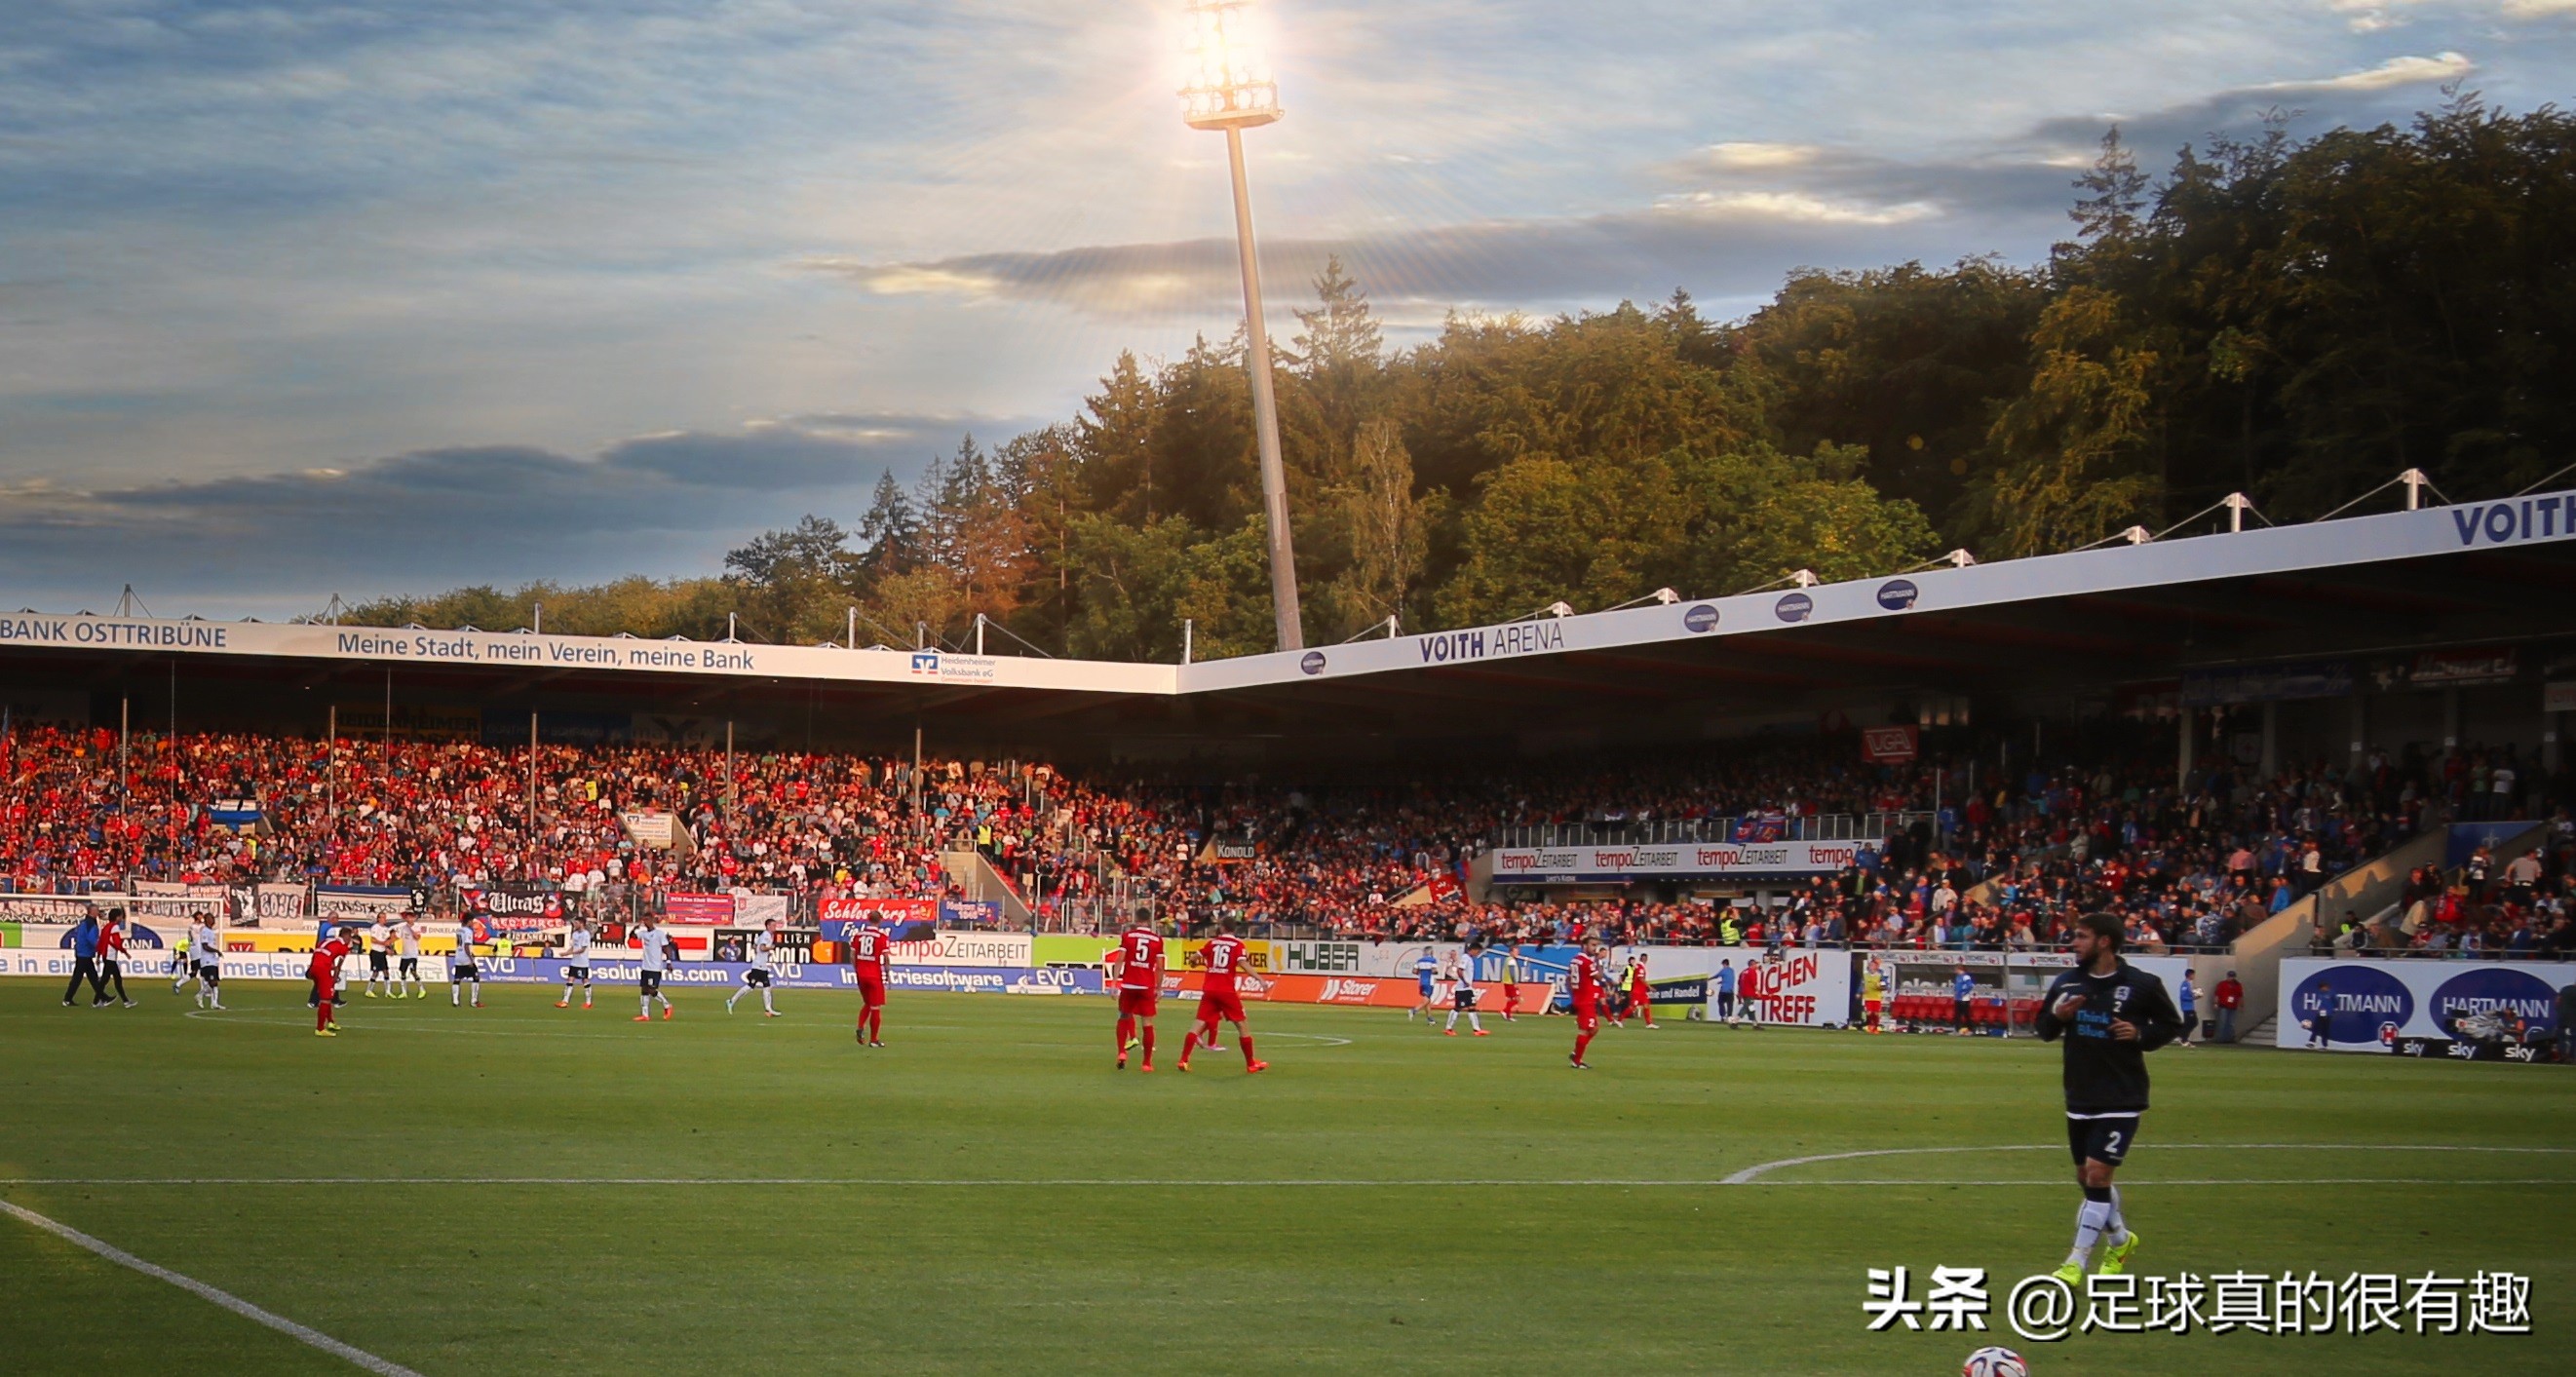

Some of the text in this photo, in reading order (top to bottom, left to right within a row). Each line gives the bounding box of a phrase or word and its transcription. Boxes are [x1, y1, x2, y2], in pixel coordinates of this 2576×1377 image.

[0, 620, 227, 649] BANK OSTTRIBÜNE
[1419, 622, 1564, 663] VOITH ARENA
[337, 633, 754, 669] Meine Stadt, mein Verein, meine Bank
[1217, 844, 1254, 858] KONOLD
[859, 936, 875, 956] 18
[888, 936, 1028, 963] empoZEITARBEIT
[1135, 938, 1150, 961] 5
[1212, 944, 1230, 968] 16
[18, 953, 38, 973] in
[2113, 1001, 2122, 1013] 2
[2403, 1043, 2425, 1057] sky
[2448, 1042, 2477, 1059] sky
[2504, 1044, 2536, 1062] sky
[2104, 1130, 2122, 1154] 2
